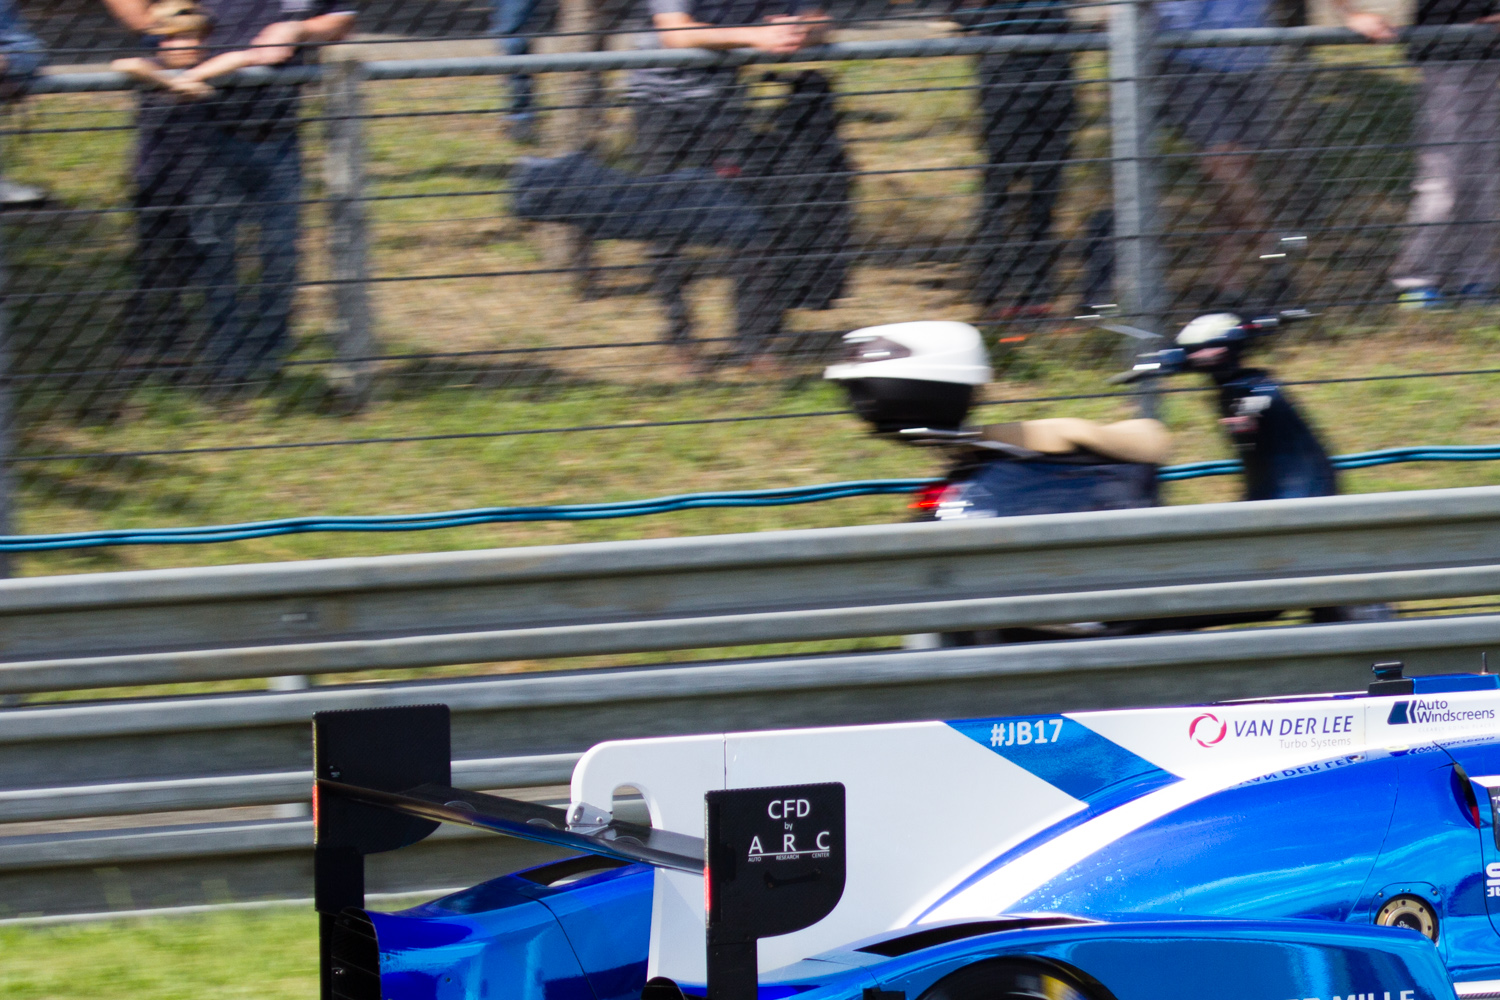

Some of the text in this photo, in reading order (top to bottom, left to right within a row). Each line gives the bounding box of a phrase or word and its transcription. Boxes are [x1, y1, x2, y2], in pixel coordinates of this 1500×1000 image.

[1417, 699, 1448, 711] Auto
[1417, 709, 1495, 723] Windscreens
[990, 719, 1063, 747] #JB17
[1234, 715, 1354, 737] VAN DER LEE
[1279, 737, 1352, 750] Turbo Systems
[767, 799, 811, 819] CFD
[784, 822, 793, 831] by
[748, 831, 830, 854] A R C
